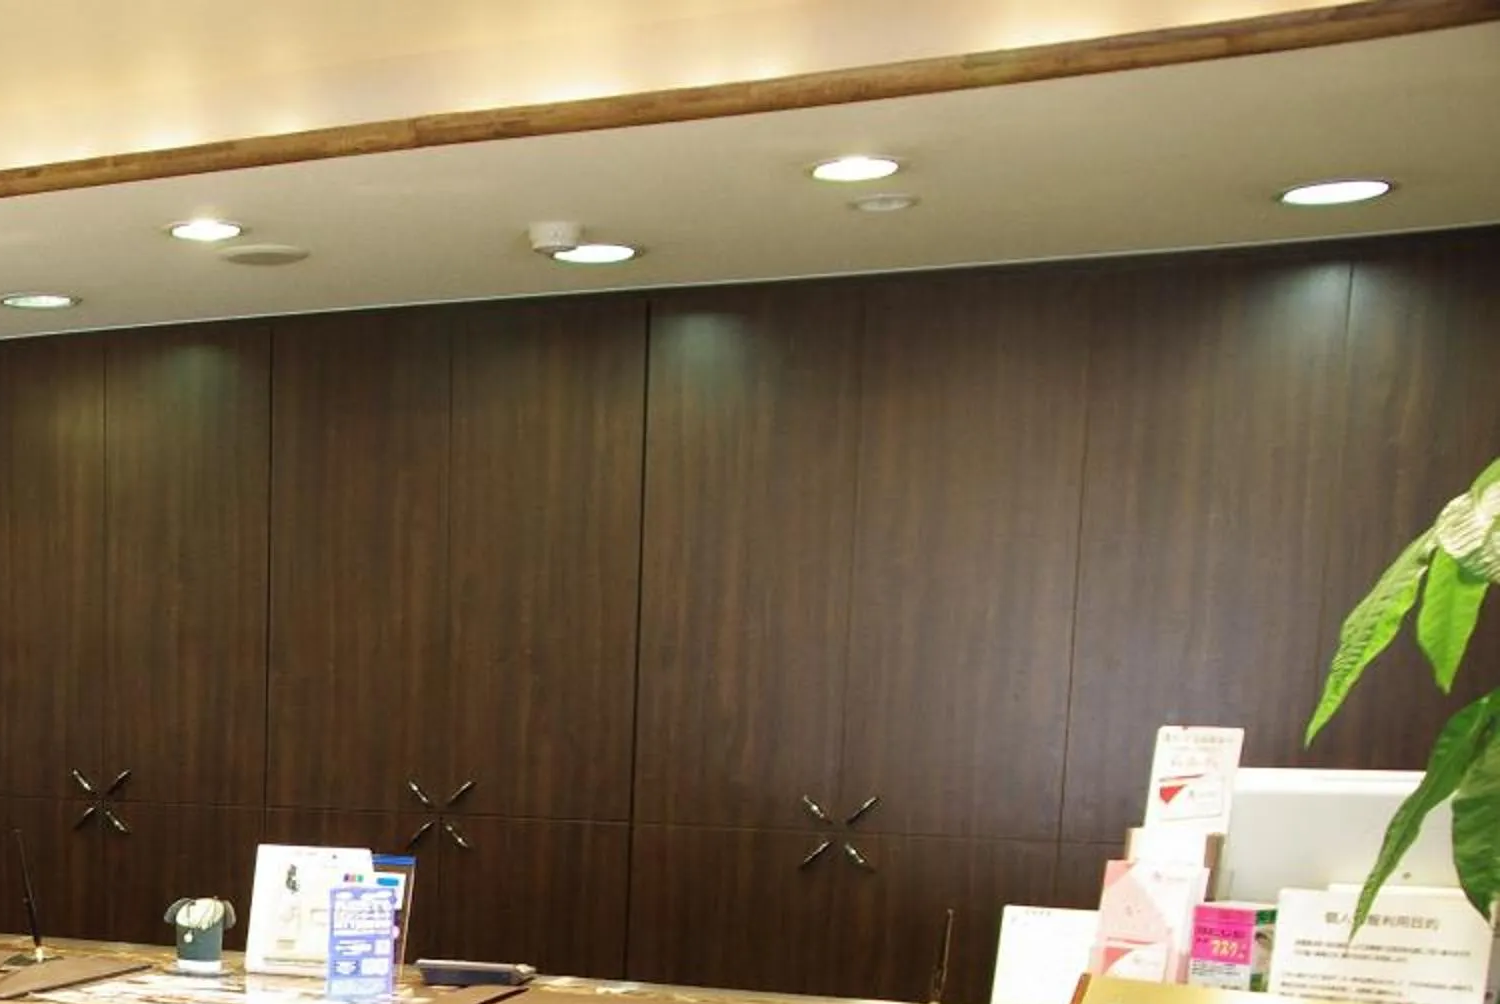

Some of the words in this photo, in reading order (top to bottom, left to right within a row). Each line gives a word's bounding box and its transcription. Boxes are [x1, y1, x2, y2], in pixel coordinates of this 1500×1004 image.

[1324, 910, 1440, 931] 個人報利用目的
